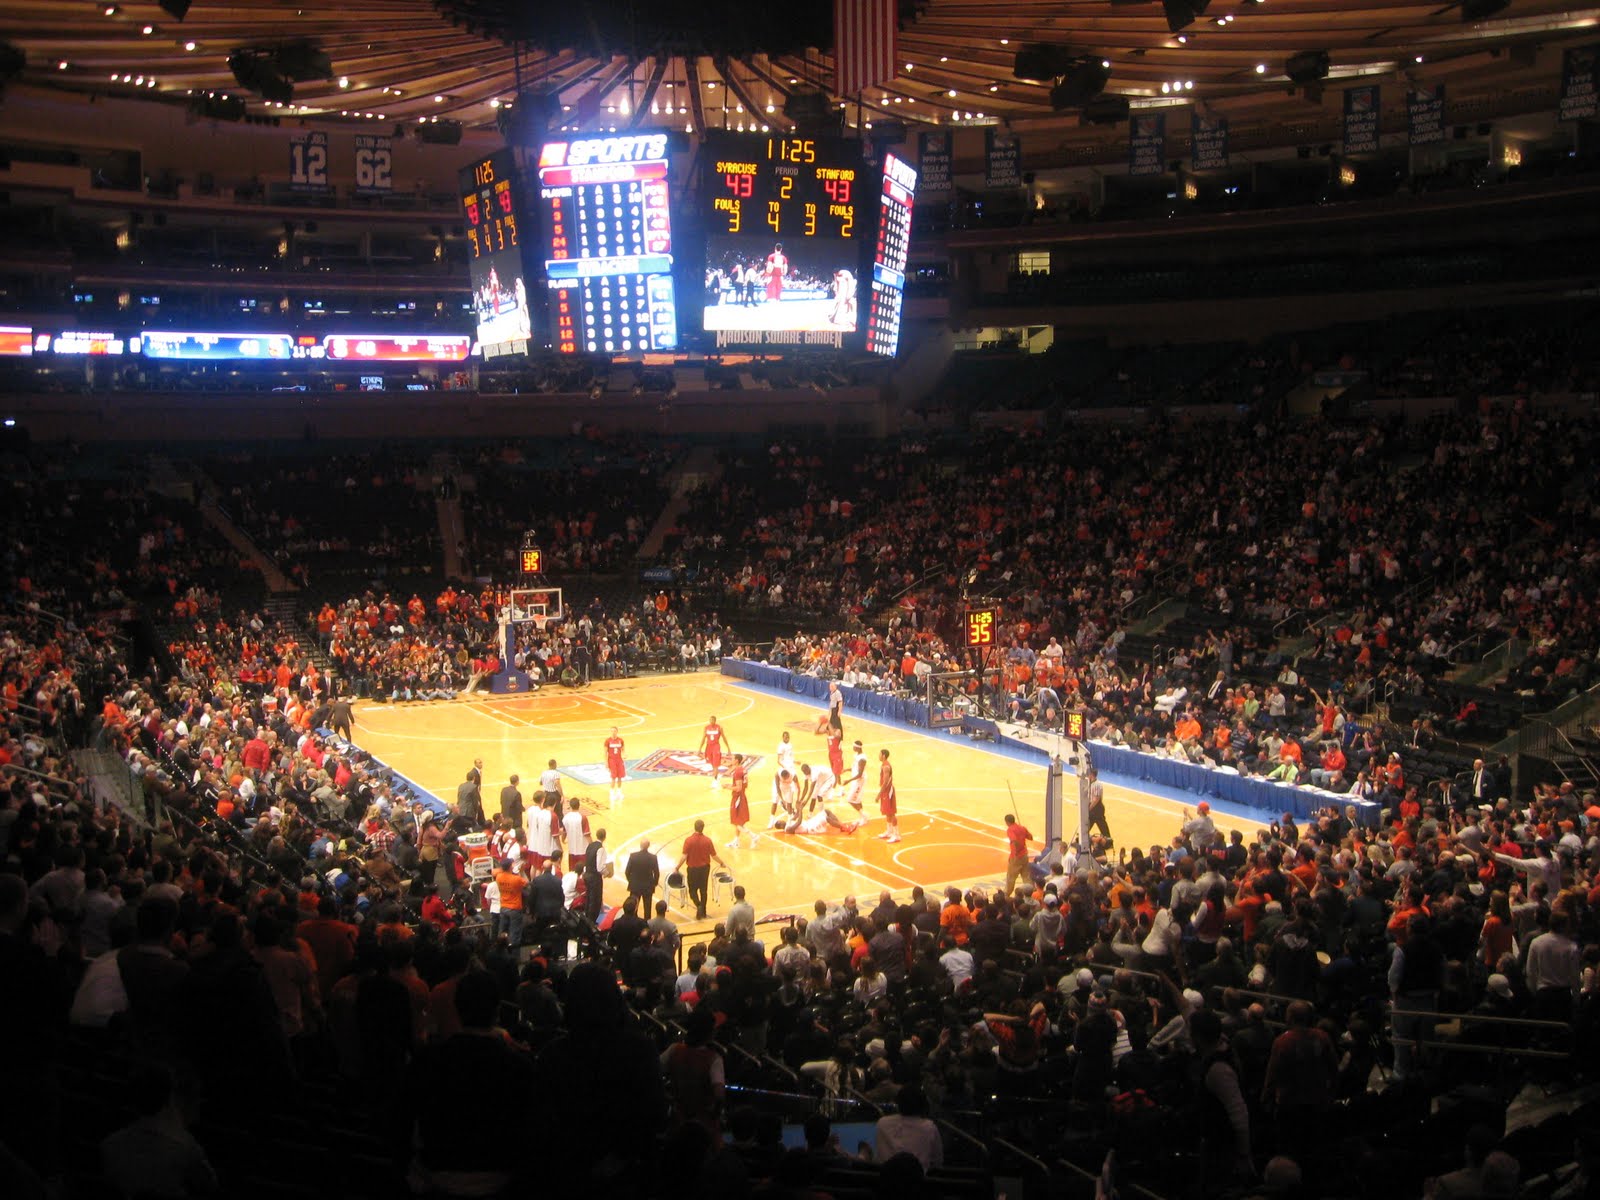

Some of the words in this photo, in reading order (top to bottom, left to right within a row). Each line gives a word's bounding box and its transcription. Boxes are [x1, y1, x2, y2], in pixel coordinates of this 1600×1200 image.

[568, 134, 667, 165] SPORTS
[768, 139, 814, 162] 11:25
[1345, 142, 1377, 152] CHAMPIONS
[292, 145, 326, 184] 12
[356, 149, 392, 188] 62
[716, 162, 758, 174] SYRACUSE
[775, 166, 798, 176] PERIOD
[816, 168, 854, 180] STANFORD
[542, 187, 572, 198] PLAYER
[726, 174, 752, 197] 43
[780, 177, 792, 198] 2
[825, 180, 850, 202] 43
[484, 198, 490, 220] 2
[714, 198, 740, 210] FOULS
[768, 202, 780, 212] TO
[805, 204, 816, 214] TO
[830, 205, 854, 216] FOULS
[554, 211, 562, 221] 3
[580, 210, 586, 220] 1
[581, 223, 587, 233] 1
[616, 220, 622, 230] 1
[632, 219, 640, 230] 7
[728, 210, 740, 232] 3
[768, 212, 779, 232] 4
[804, 214, 816, 236] 3
[842, 216, 853, 236] 2
[552, 236, 568, 248] 24
[582, 236, 588, 246] 1
[548, 279, 578, 288] PLAYER
[559, 290, 567, 300] 3
[585, 288, 591, 298] 1
[560, 303, 568, 313] 5
[637, 298, 645, 310] 7
[560, 316, 572, 326] 11
[560, 329, 574, 340] 12
[716, 330, 762, 348] MADISON
[765, 330, 801, 344] SQUARE
[804, 330, 842, 348] GARDEN
[560, 342, 574, 352] 43
[524, 559, 538, 570] 35
[970, 612, 992, 624] 11:25
[970, 624, 990, 644] 35
[1069, 724, 1080, 736] 35
